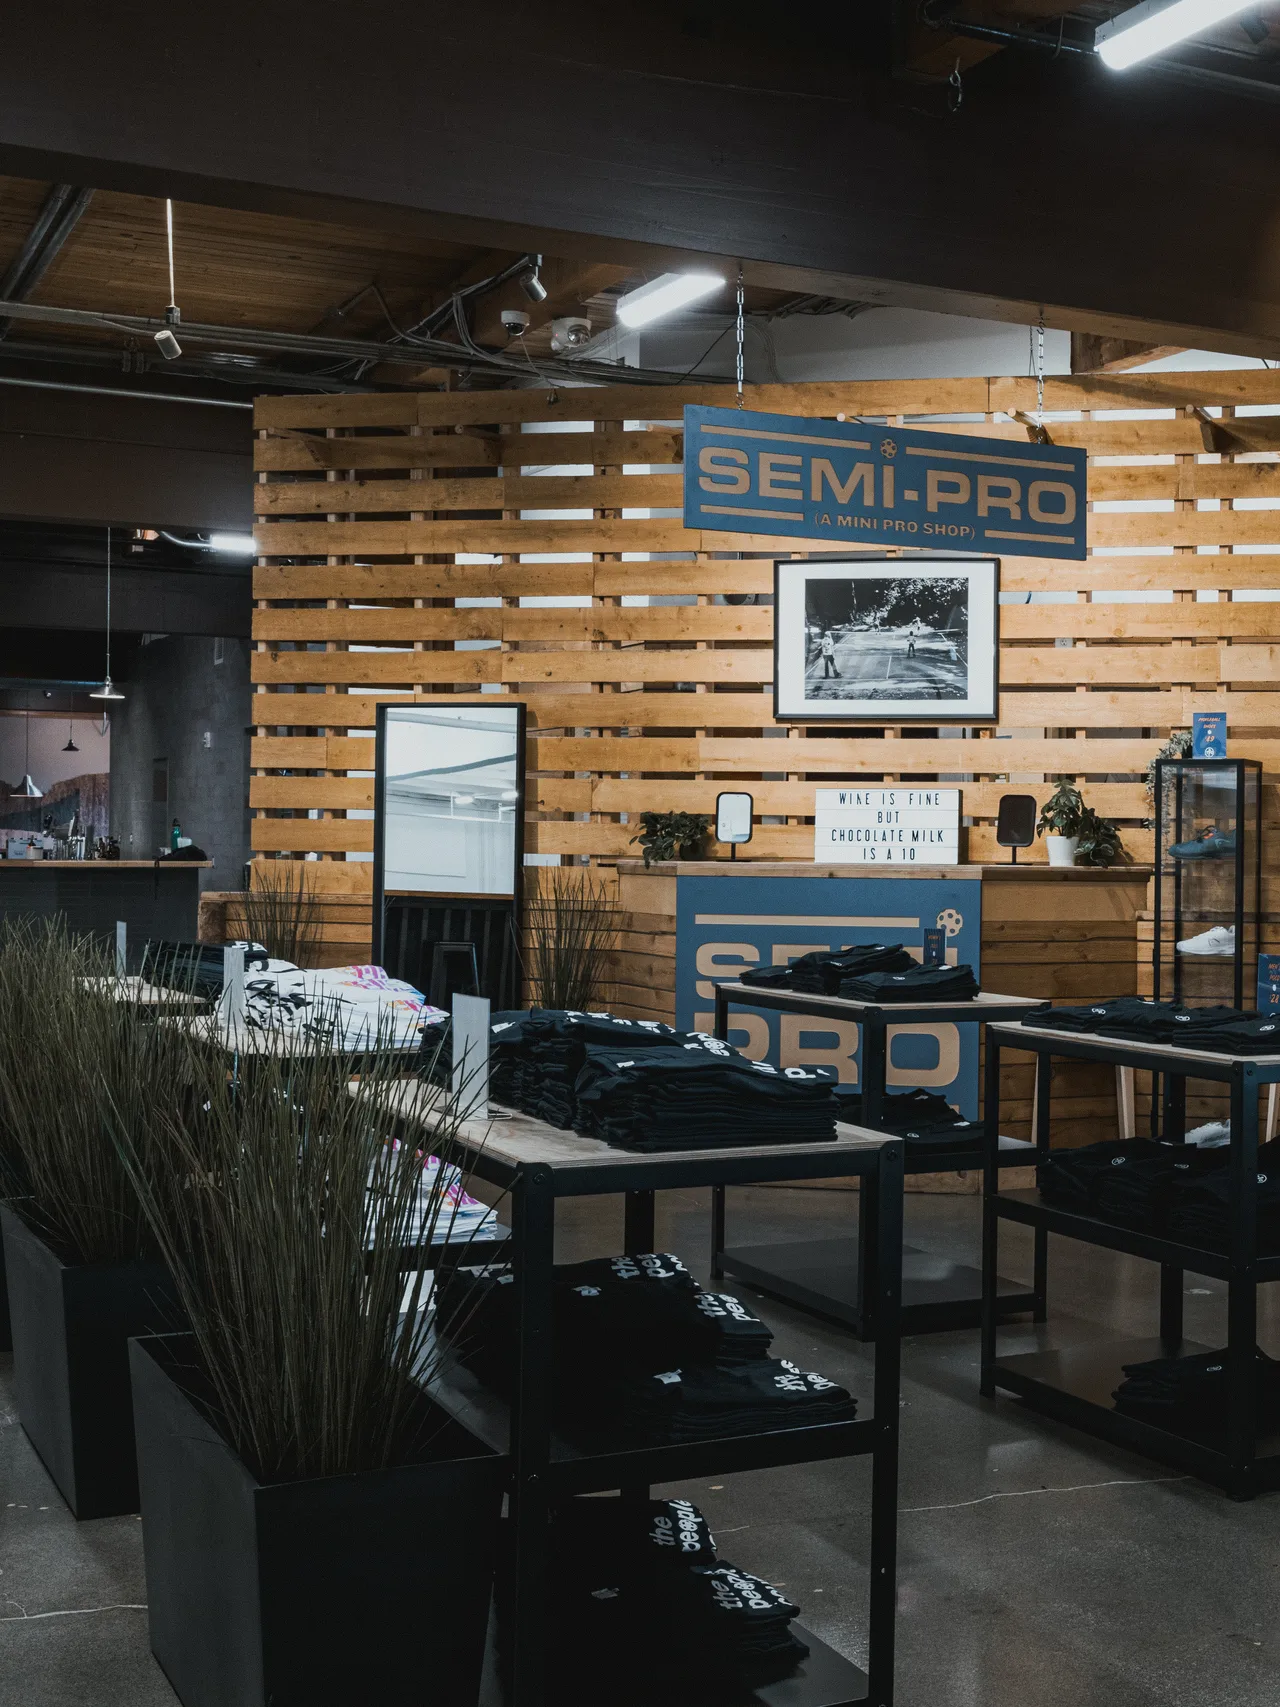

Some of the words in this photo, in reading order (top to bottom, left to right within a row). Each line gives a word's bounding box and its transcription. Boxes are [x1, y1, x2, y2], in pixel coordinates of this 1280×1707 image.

[813, 512, 831, 526] (A
[837, 515, 877, 530] MINI
[883, 519, 918, 533] PRO
[923, 522, 976, 540] SHOP)
[839, 792, 870, 805] WINE
[882, 793, 895, 805] IS
[909, 793, 940, 806] FINE
[877, 811, 899, 824] BUT
[831, 829, 904, 842] CHOCOLATE
[911, 830, 944, 843] MILK
[863, 848, 876, 860] IS
[886, 848, 892, 860] A
[902, 848, 916, 861] 10
[611, 1256, 641, 1280] the
[697, 1293, 728, 1318] the
[649, 1516, 677, 1546] the
[711, 1580, 744, 1610] the
